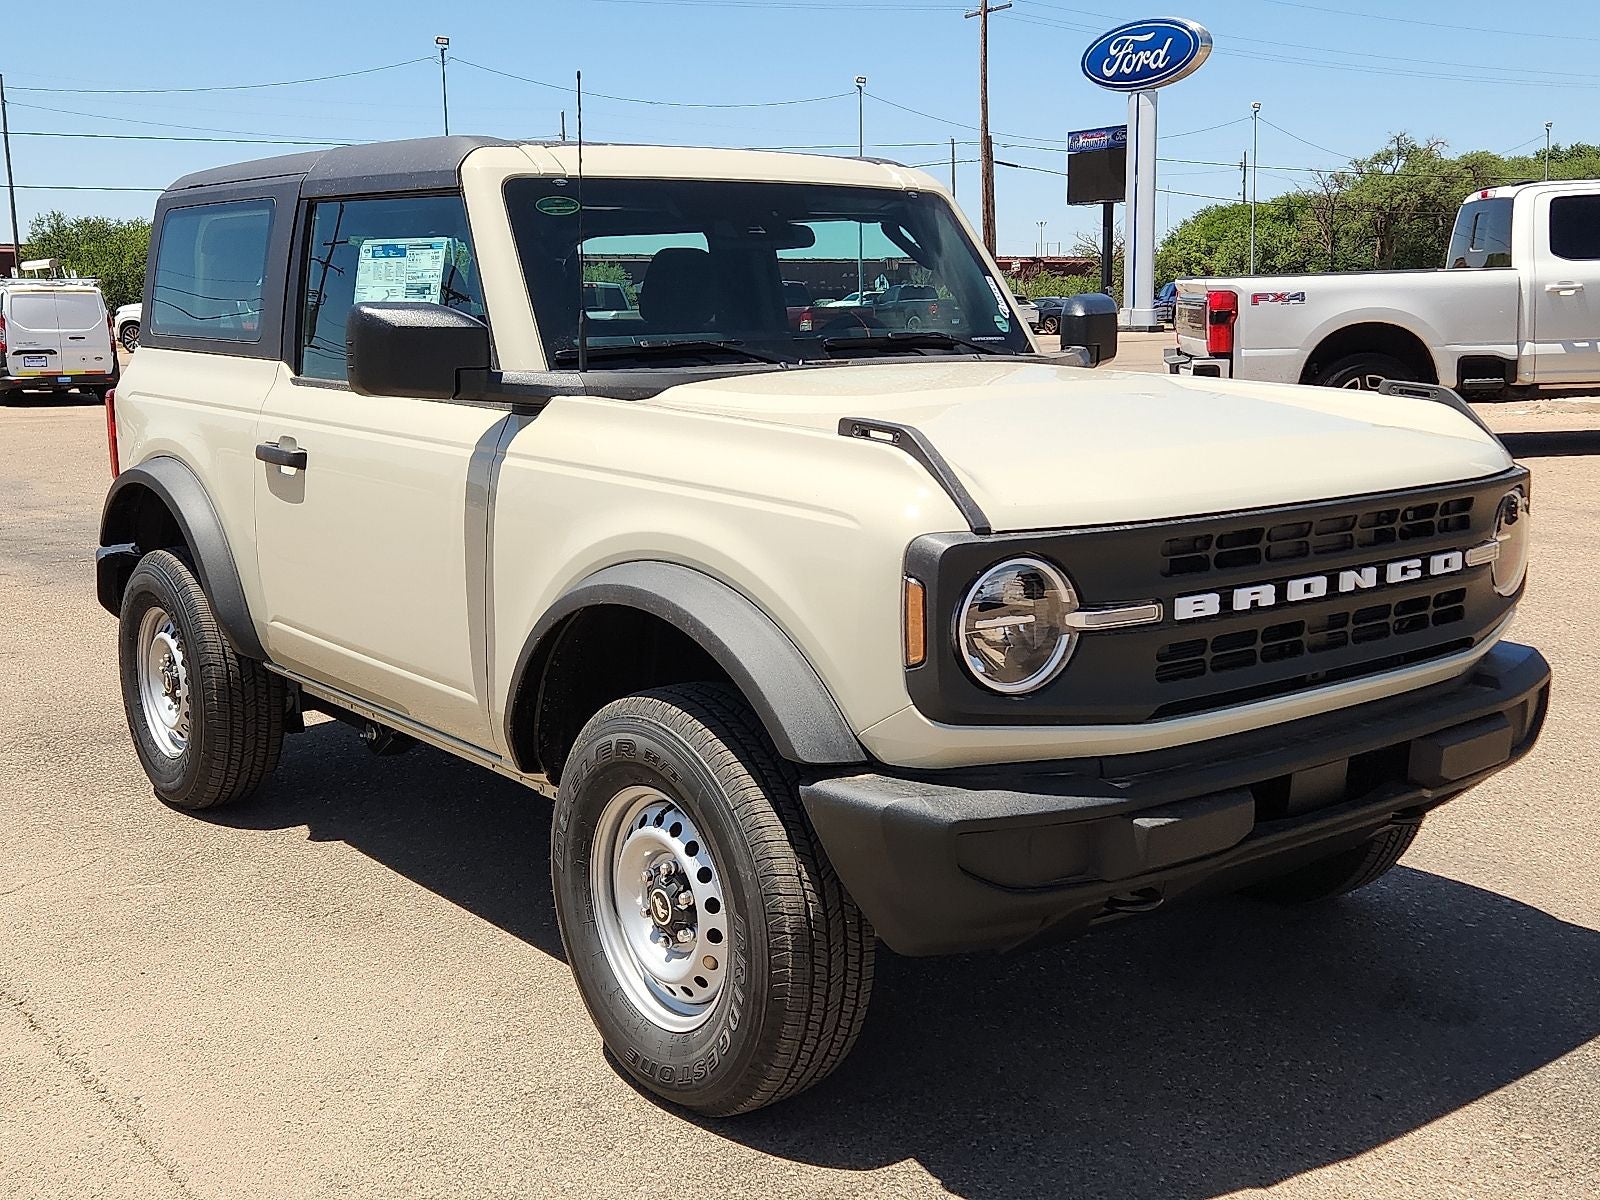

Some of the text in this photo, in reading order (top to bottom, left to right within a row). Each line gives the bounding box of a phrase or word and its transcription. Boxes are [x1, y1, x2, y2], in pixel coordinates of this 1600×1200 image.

[1102, 32, 1173, 77] Ford
[1070, 141, 1080, 150] BIG
[1082, 138, 1110, 149] COUNTRY
[1251, 292, 1305, 305] FX4
[1174, 551, 1463, 620] BRONCO
[624, 913, 748, 1086] BRIDGESTONE
